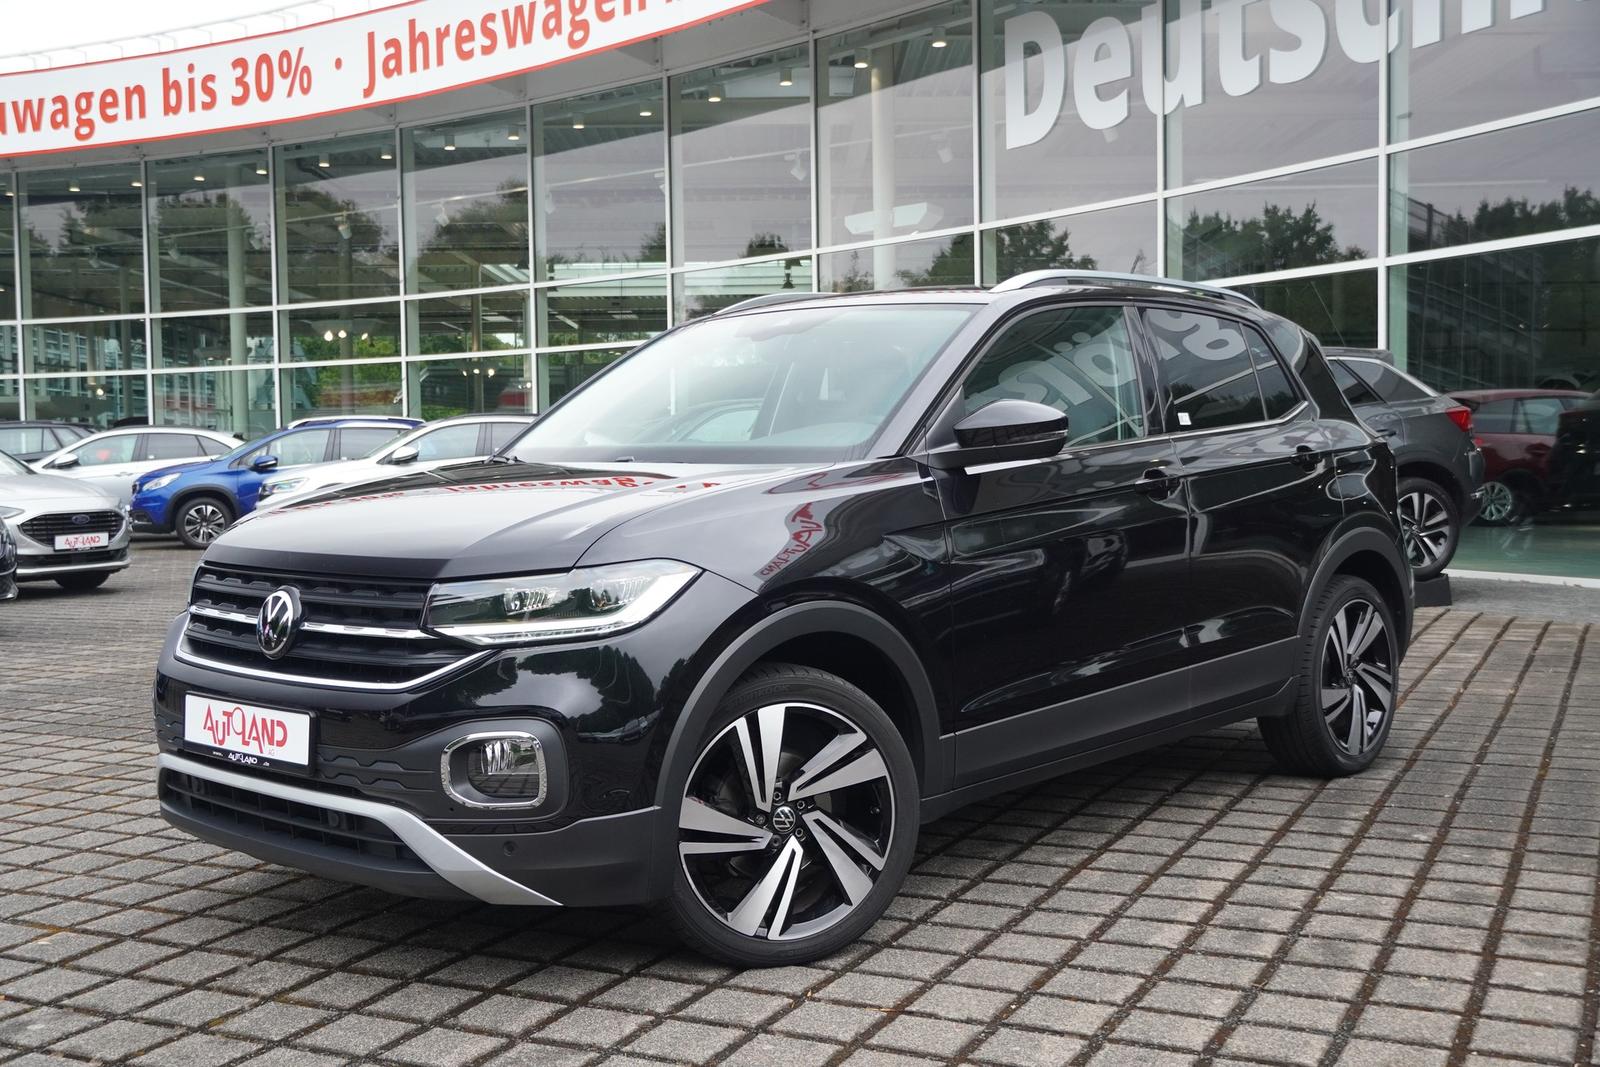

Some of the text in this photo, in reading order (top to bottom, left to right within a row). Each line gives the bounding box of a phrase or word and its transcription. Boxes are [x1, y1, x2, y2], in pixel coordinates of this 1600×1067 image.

[0, 0, 647, 141] wagen bis 30% Jahreswag
